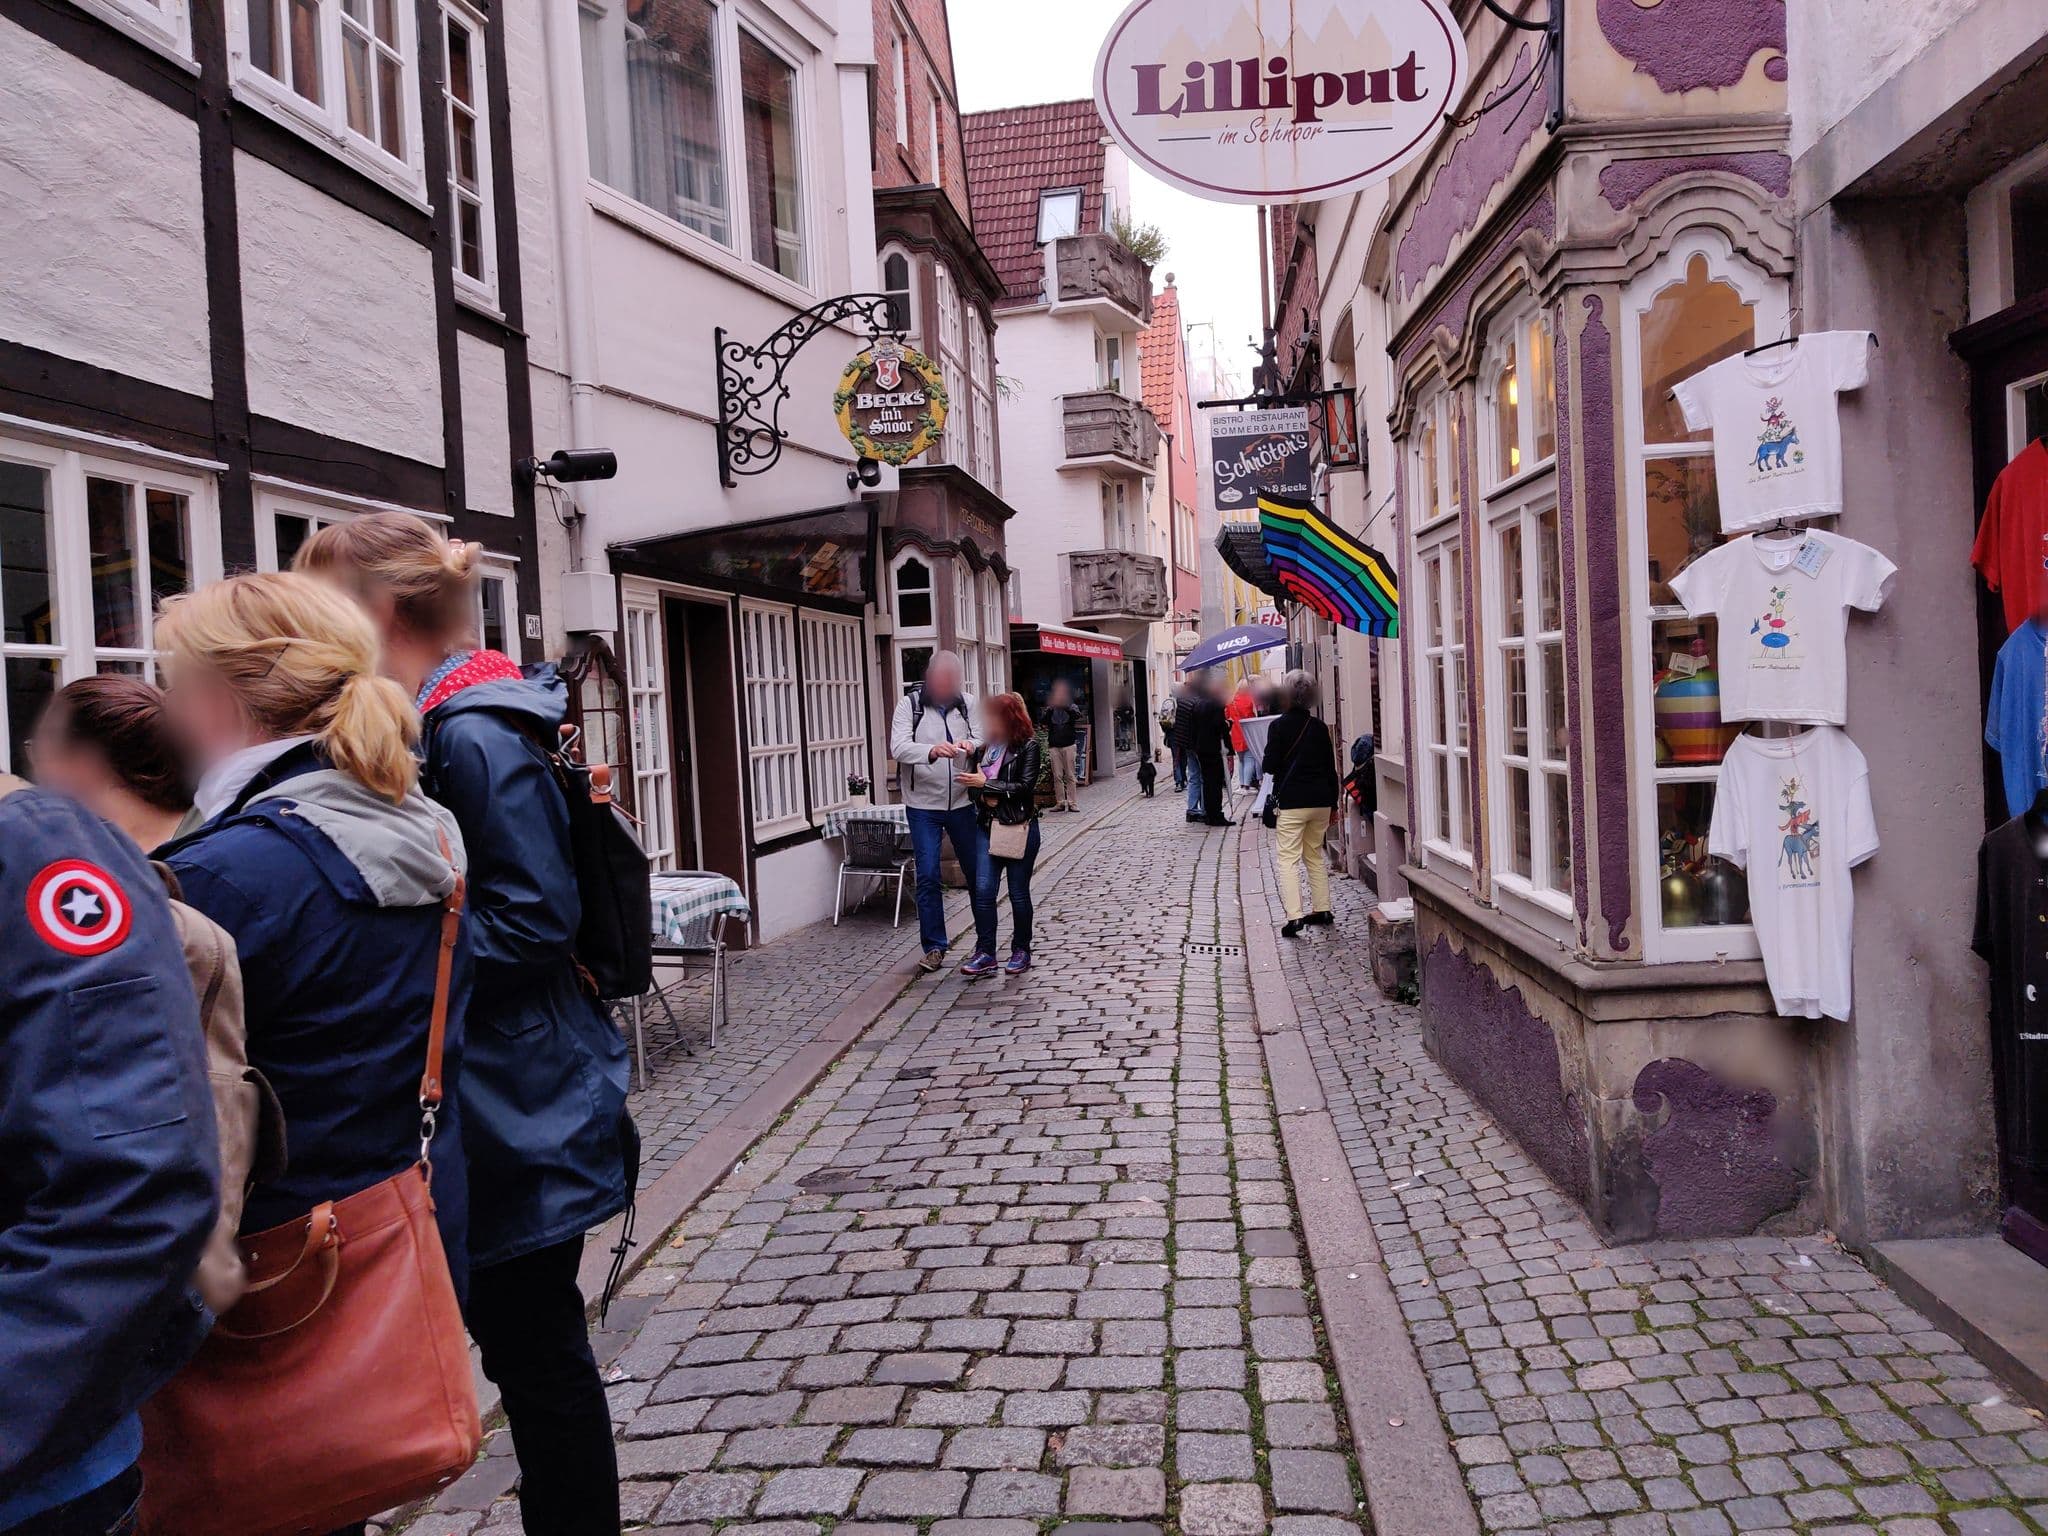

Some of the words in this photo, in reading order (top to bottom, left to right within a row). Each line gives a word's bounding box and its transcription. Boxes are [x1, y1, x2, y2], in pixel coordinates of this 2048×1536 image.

[1131, 50, 1429, 124] Lilliput
[1217, 125, 1239, 144] im
[1243, 117, 1324, 144] Schnoor
[1213, 416, 1243, 425] BISTRO
[1250, 411, 1305, 422] RESTAURANT
[869, 419, 914, 435] Snoor
[1213, 422, 1306, 435] SOMMERGARTEN
[1214, 433, 1308, 485] Schröter's
[1261, 613, 1283, 626] EIS
